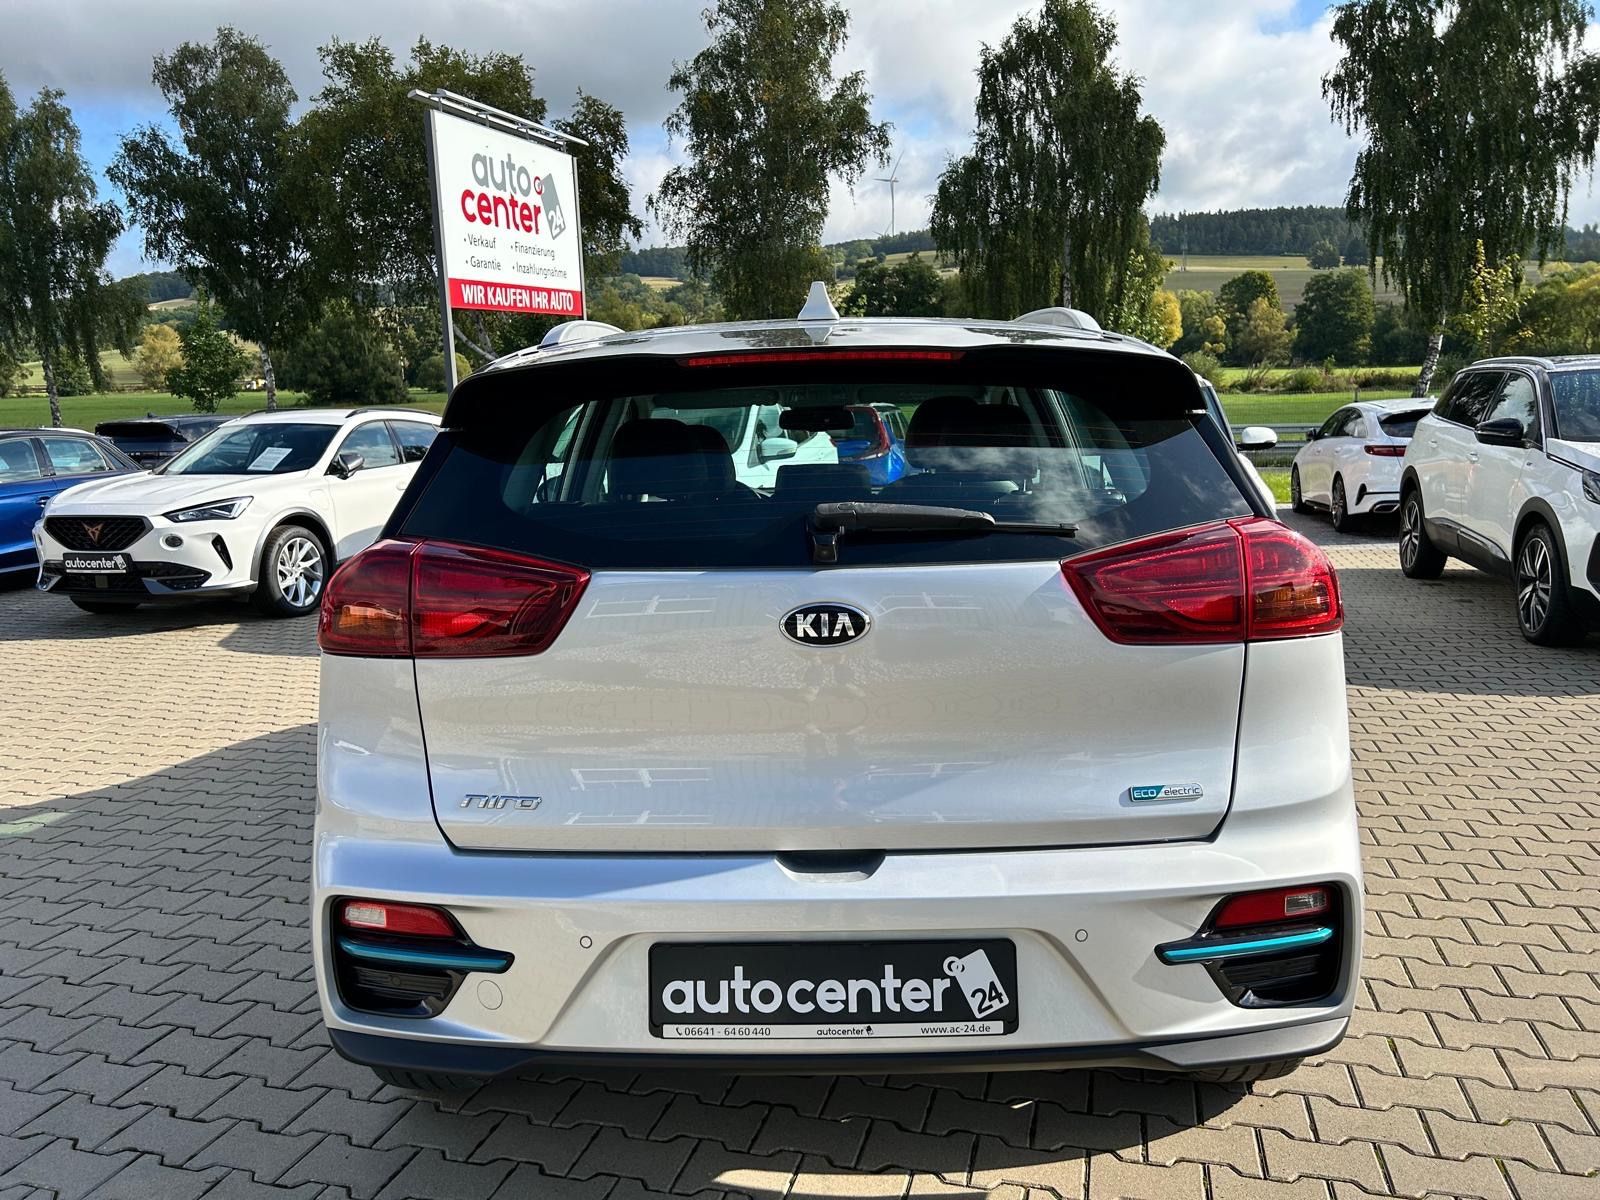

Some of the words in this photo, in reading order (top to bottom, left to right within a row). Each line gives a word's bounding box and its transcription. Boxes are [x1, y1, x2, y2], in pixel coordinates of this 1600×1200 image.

[472, 152, 531, 197] auto
[461, 189, 542, 235] center
[548, 205, 565, 234] 24
[468, 233, 496, 250] Verkauf
[514, 241, 556, 261] Finanzierung
[470, 255, 502, 271] Garantie
[516, 262, 567, 279] Inzahlungnahme
[461, 283, 485, 305] WIR
[487, 286, 531, 309] KAUFEN
[532, 290, 549, 309] IHR
[550, 291, 573, 311] AUTO
[65, 556, 116, 569] autocenter
[795, 612, 856, 638] KIA
[1134, 789, 1157, 798] ECO
[1164, 787, 1201, 796] electric
[662, 964, 951, 1015] autocenter
[969, 980, 1004, 1015] 24
[684, 1027, 715, 1037] 06641
[816, 1027, 865, 1036] autocenter
[920, 1024, 991, 1035] www.ac-24.de
